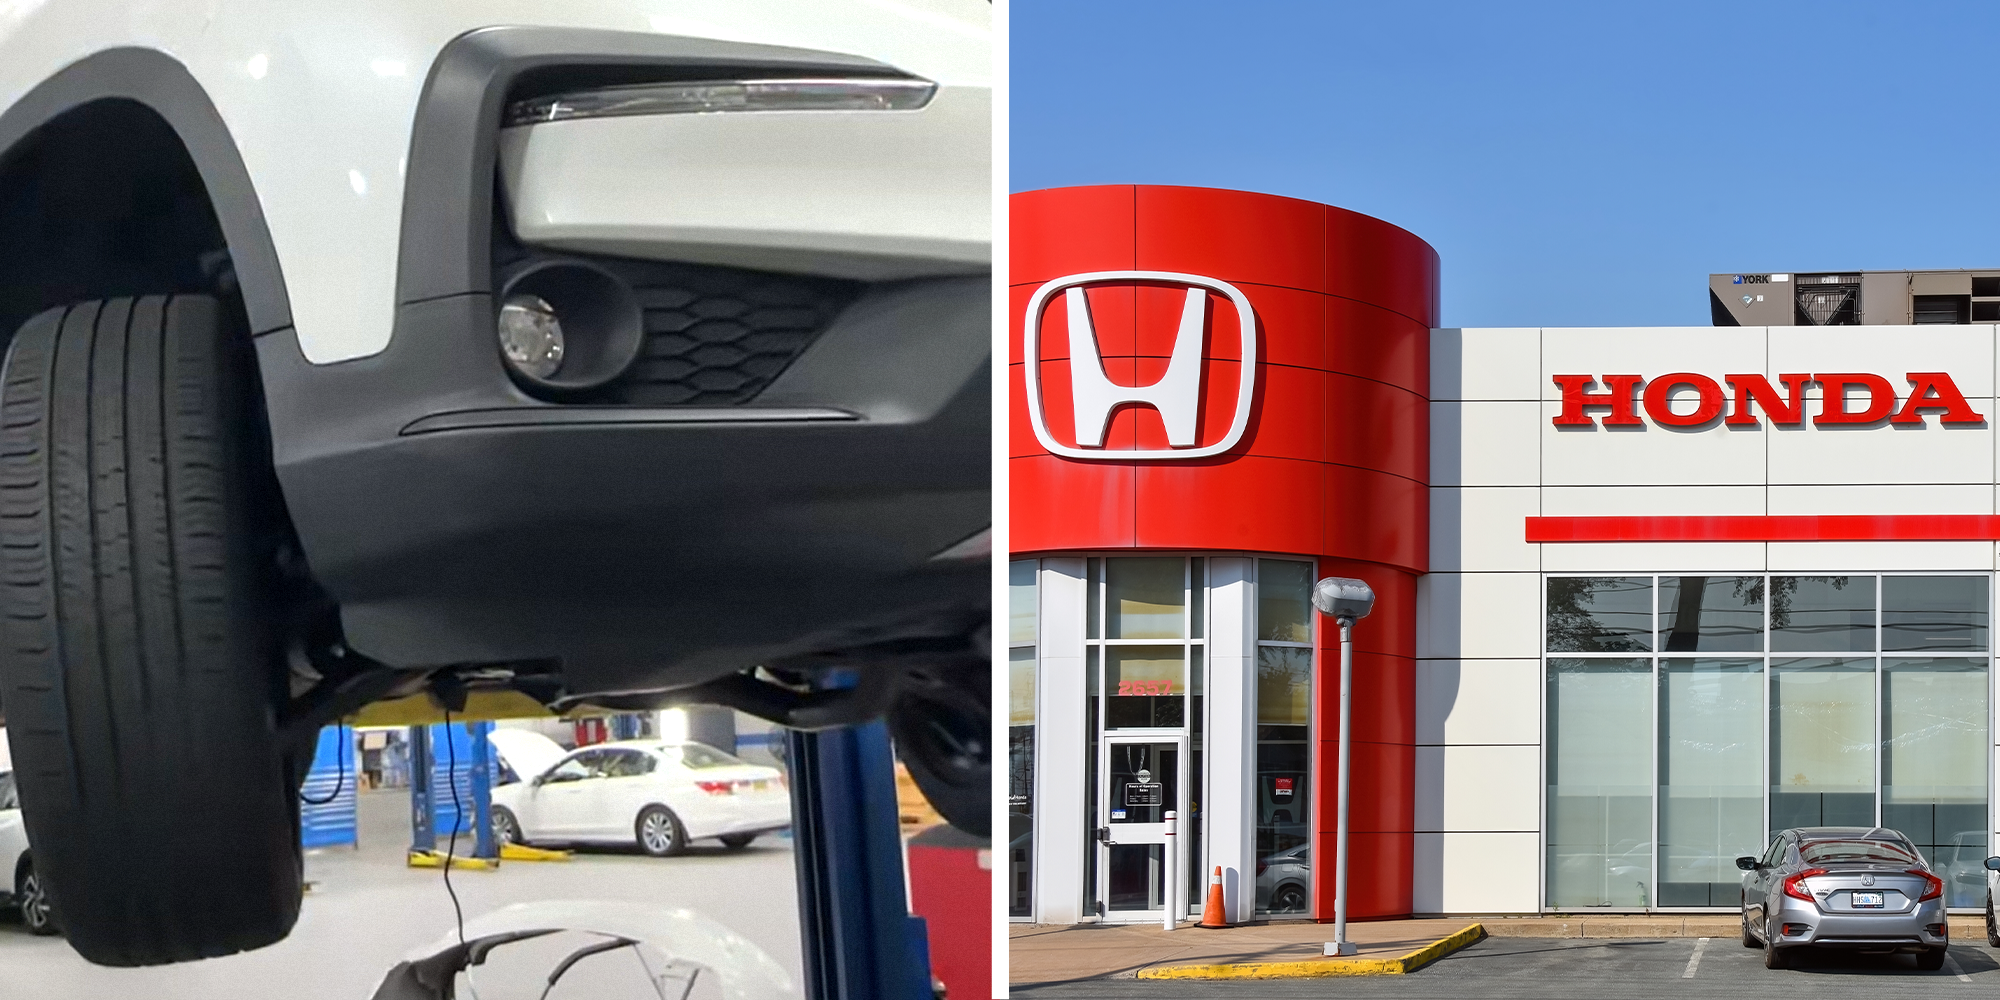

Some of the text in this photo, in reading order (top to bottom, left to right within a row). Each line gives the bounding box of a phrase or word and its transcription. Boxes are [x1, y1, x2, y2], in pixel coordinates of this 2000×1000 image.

[1742, 275, 1769, 284] YORK
[1065, 286, 1206, 447] H
[1552, 372, 1984, 427] HONDA
[1118, 680, 1173, 696] 2657
